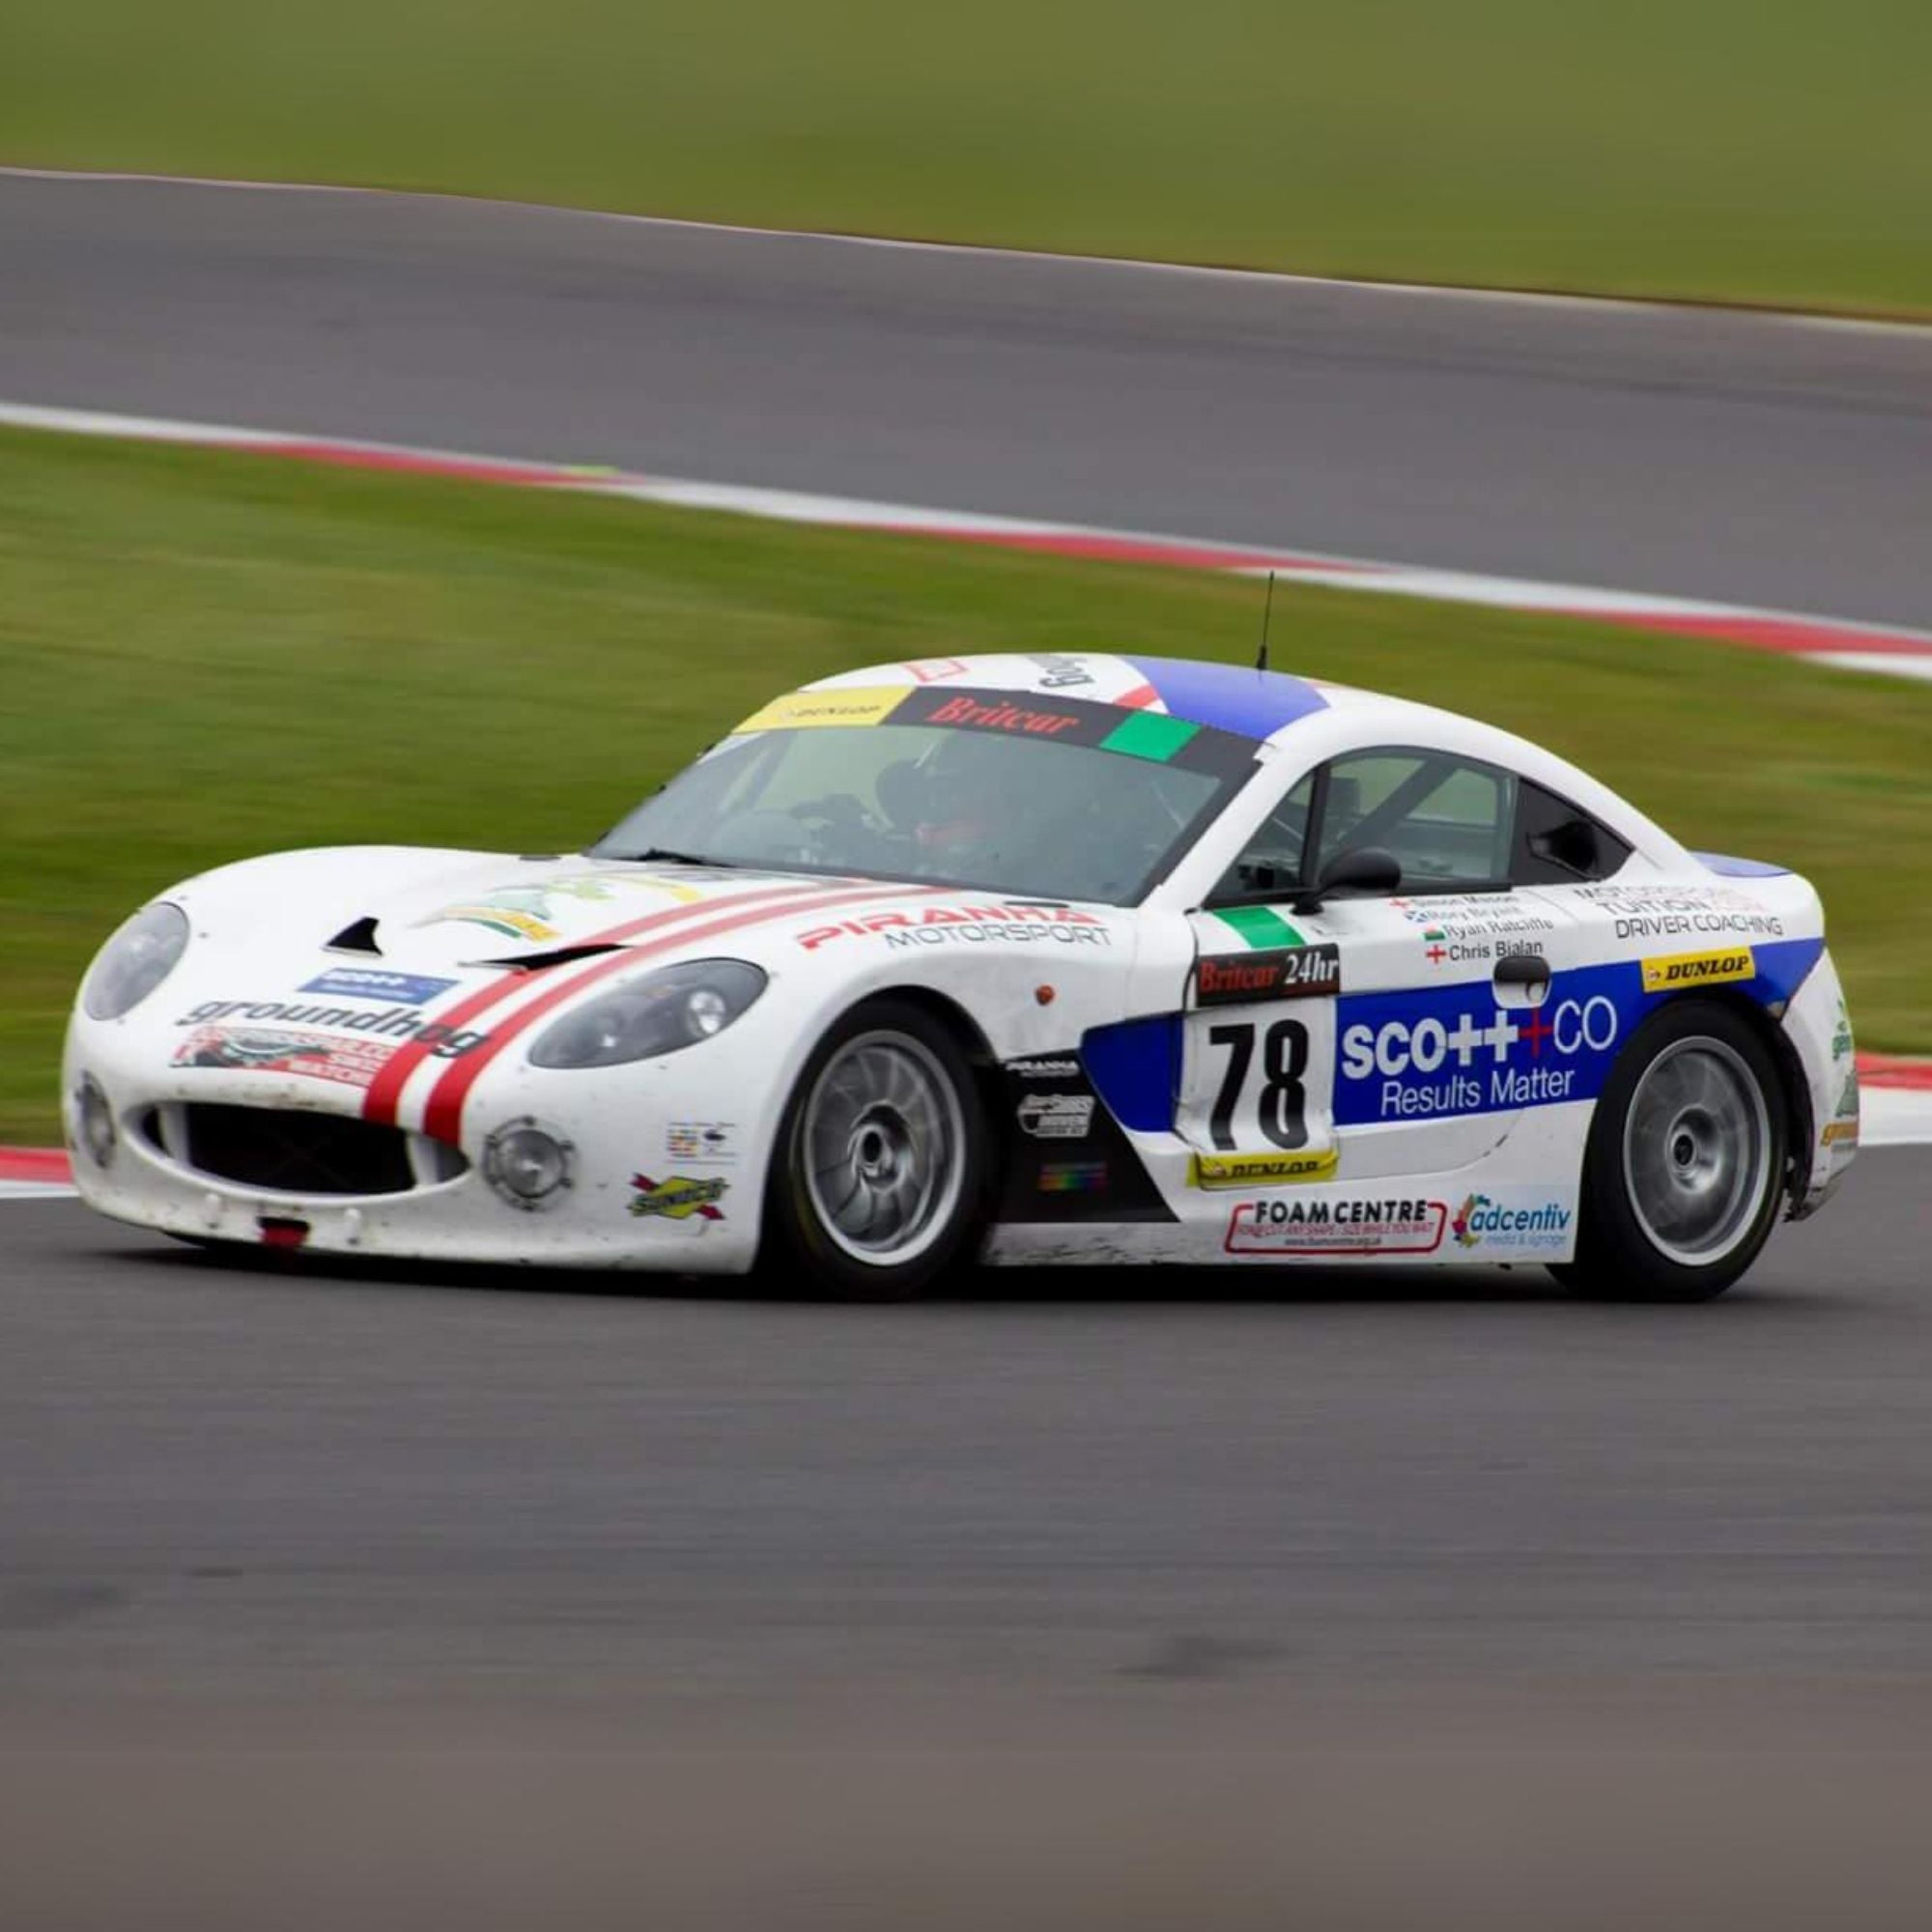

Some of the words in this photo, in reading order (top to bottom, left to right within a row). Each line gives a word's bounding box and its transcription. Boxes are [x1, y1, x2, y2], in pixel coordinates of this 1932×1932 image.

[924, 696, 1081, 735] Britcar
[795, 905, 1102, 951] PIRANHA
[881, 923, 1113, 950] MOTORSPORT
[1614, 917, 1690, 939] DRIVER
[1692, 915, 1784, 936] COACHING
[1449, 942, 1491, 961] Chris
[1664, 954, 1750, 981] DUNLOP
[1199, 959, 1280, 993] Britcar
[1284, 951, 1339, 985] 24hr
[174, 1000, 490, 1059] groundhog
[1208, 1018, 1310, 1151] 78
[1380, 1074, 1482, 1118] Results
[1490, 1065, 1577, 1105] Matter
[1469, 1203, 1571, 1232] adcentiv
